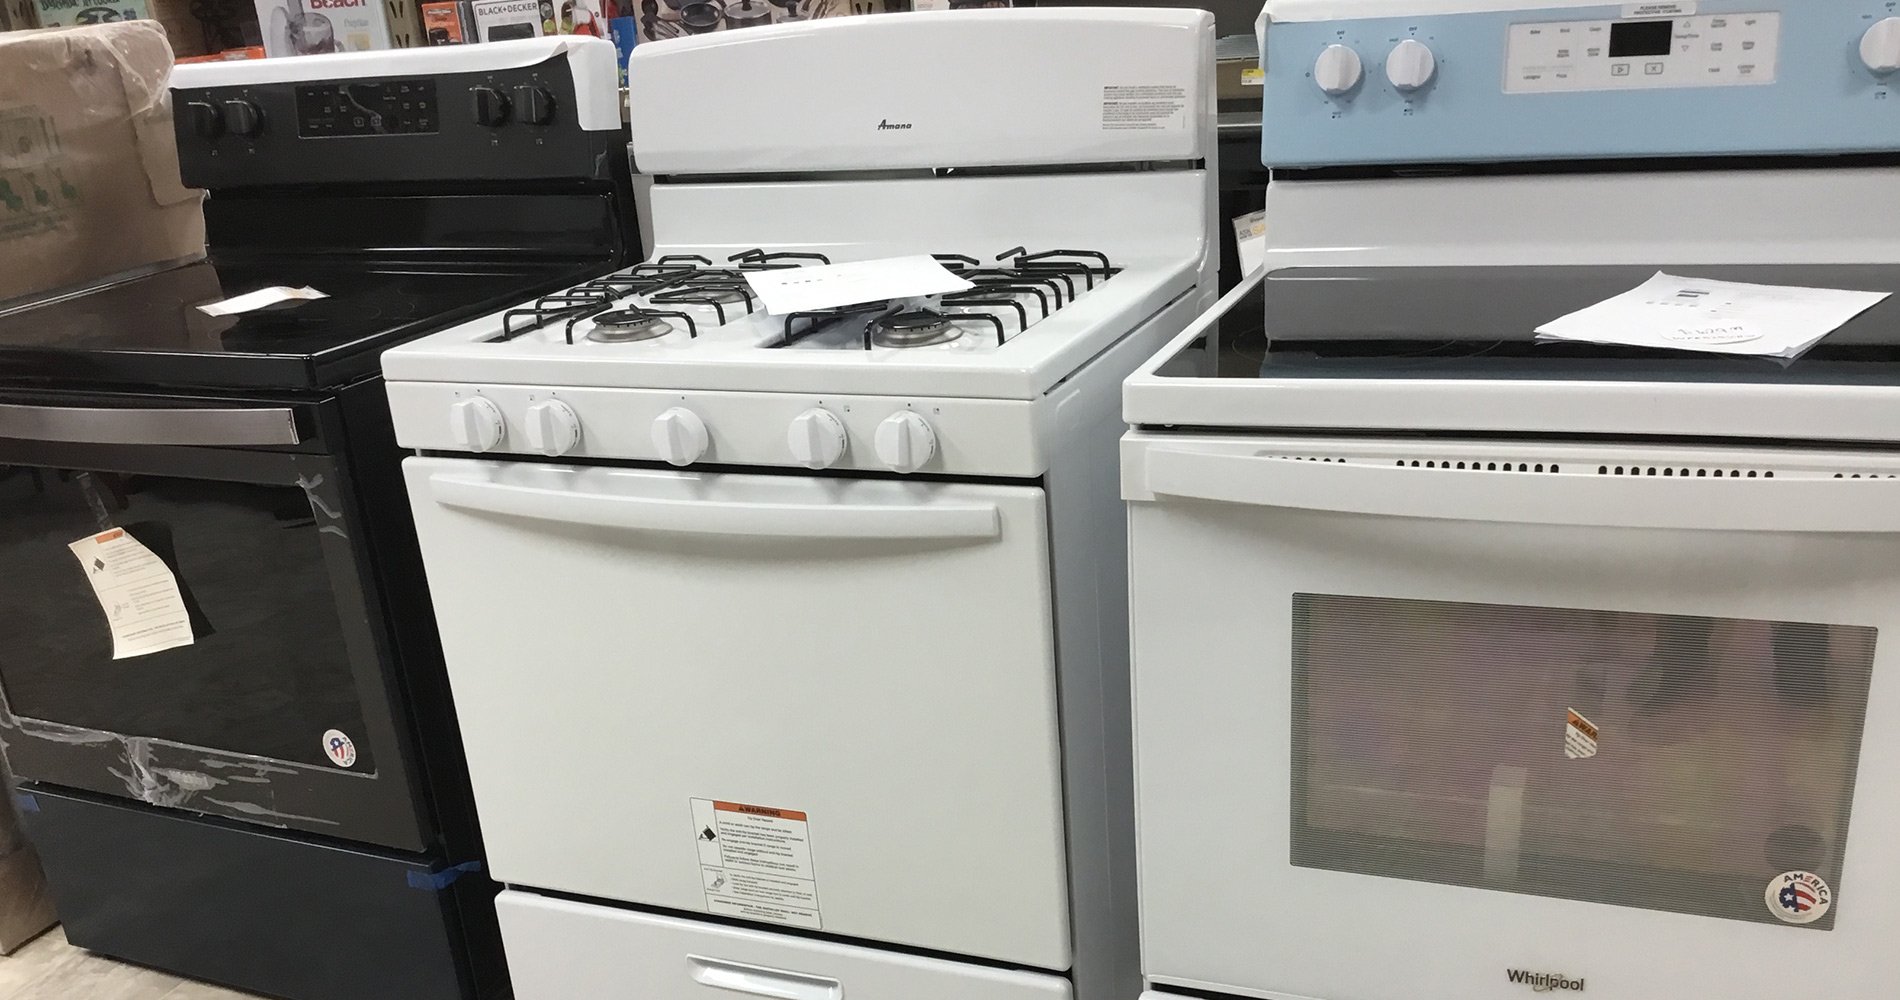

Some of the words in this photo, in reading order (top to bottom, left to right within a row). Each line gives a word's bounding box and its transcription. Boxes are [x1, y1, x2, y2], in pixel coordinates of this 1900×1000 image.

[477, 2, 538, 16] BLACK+DECKER
[877, 119, 912, 131] Amana
[743, 806, 781, 817] WARNING
[1784, 873, 1829, 905] AMERICA
[1506, 968, 1585, 992] Whirlpool
